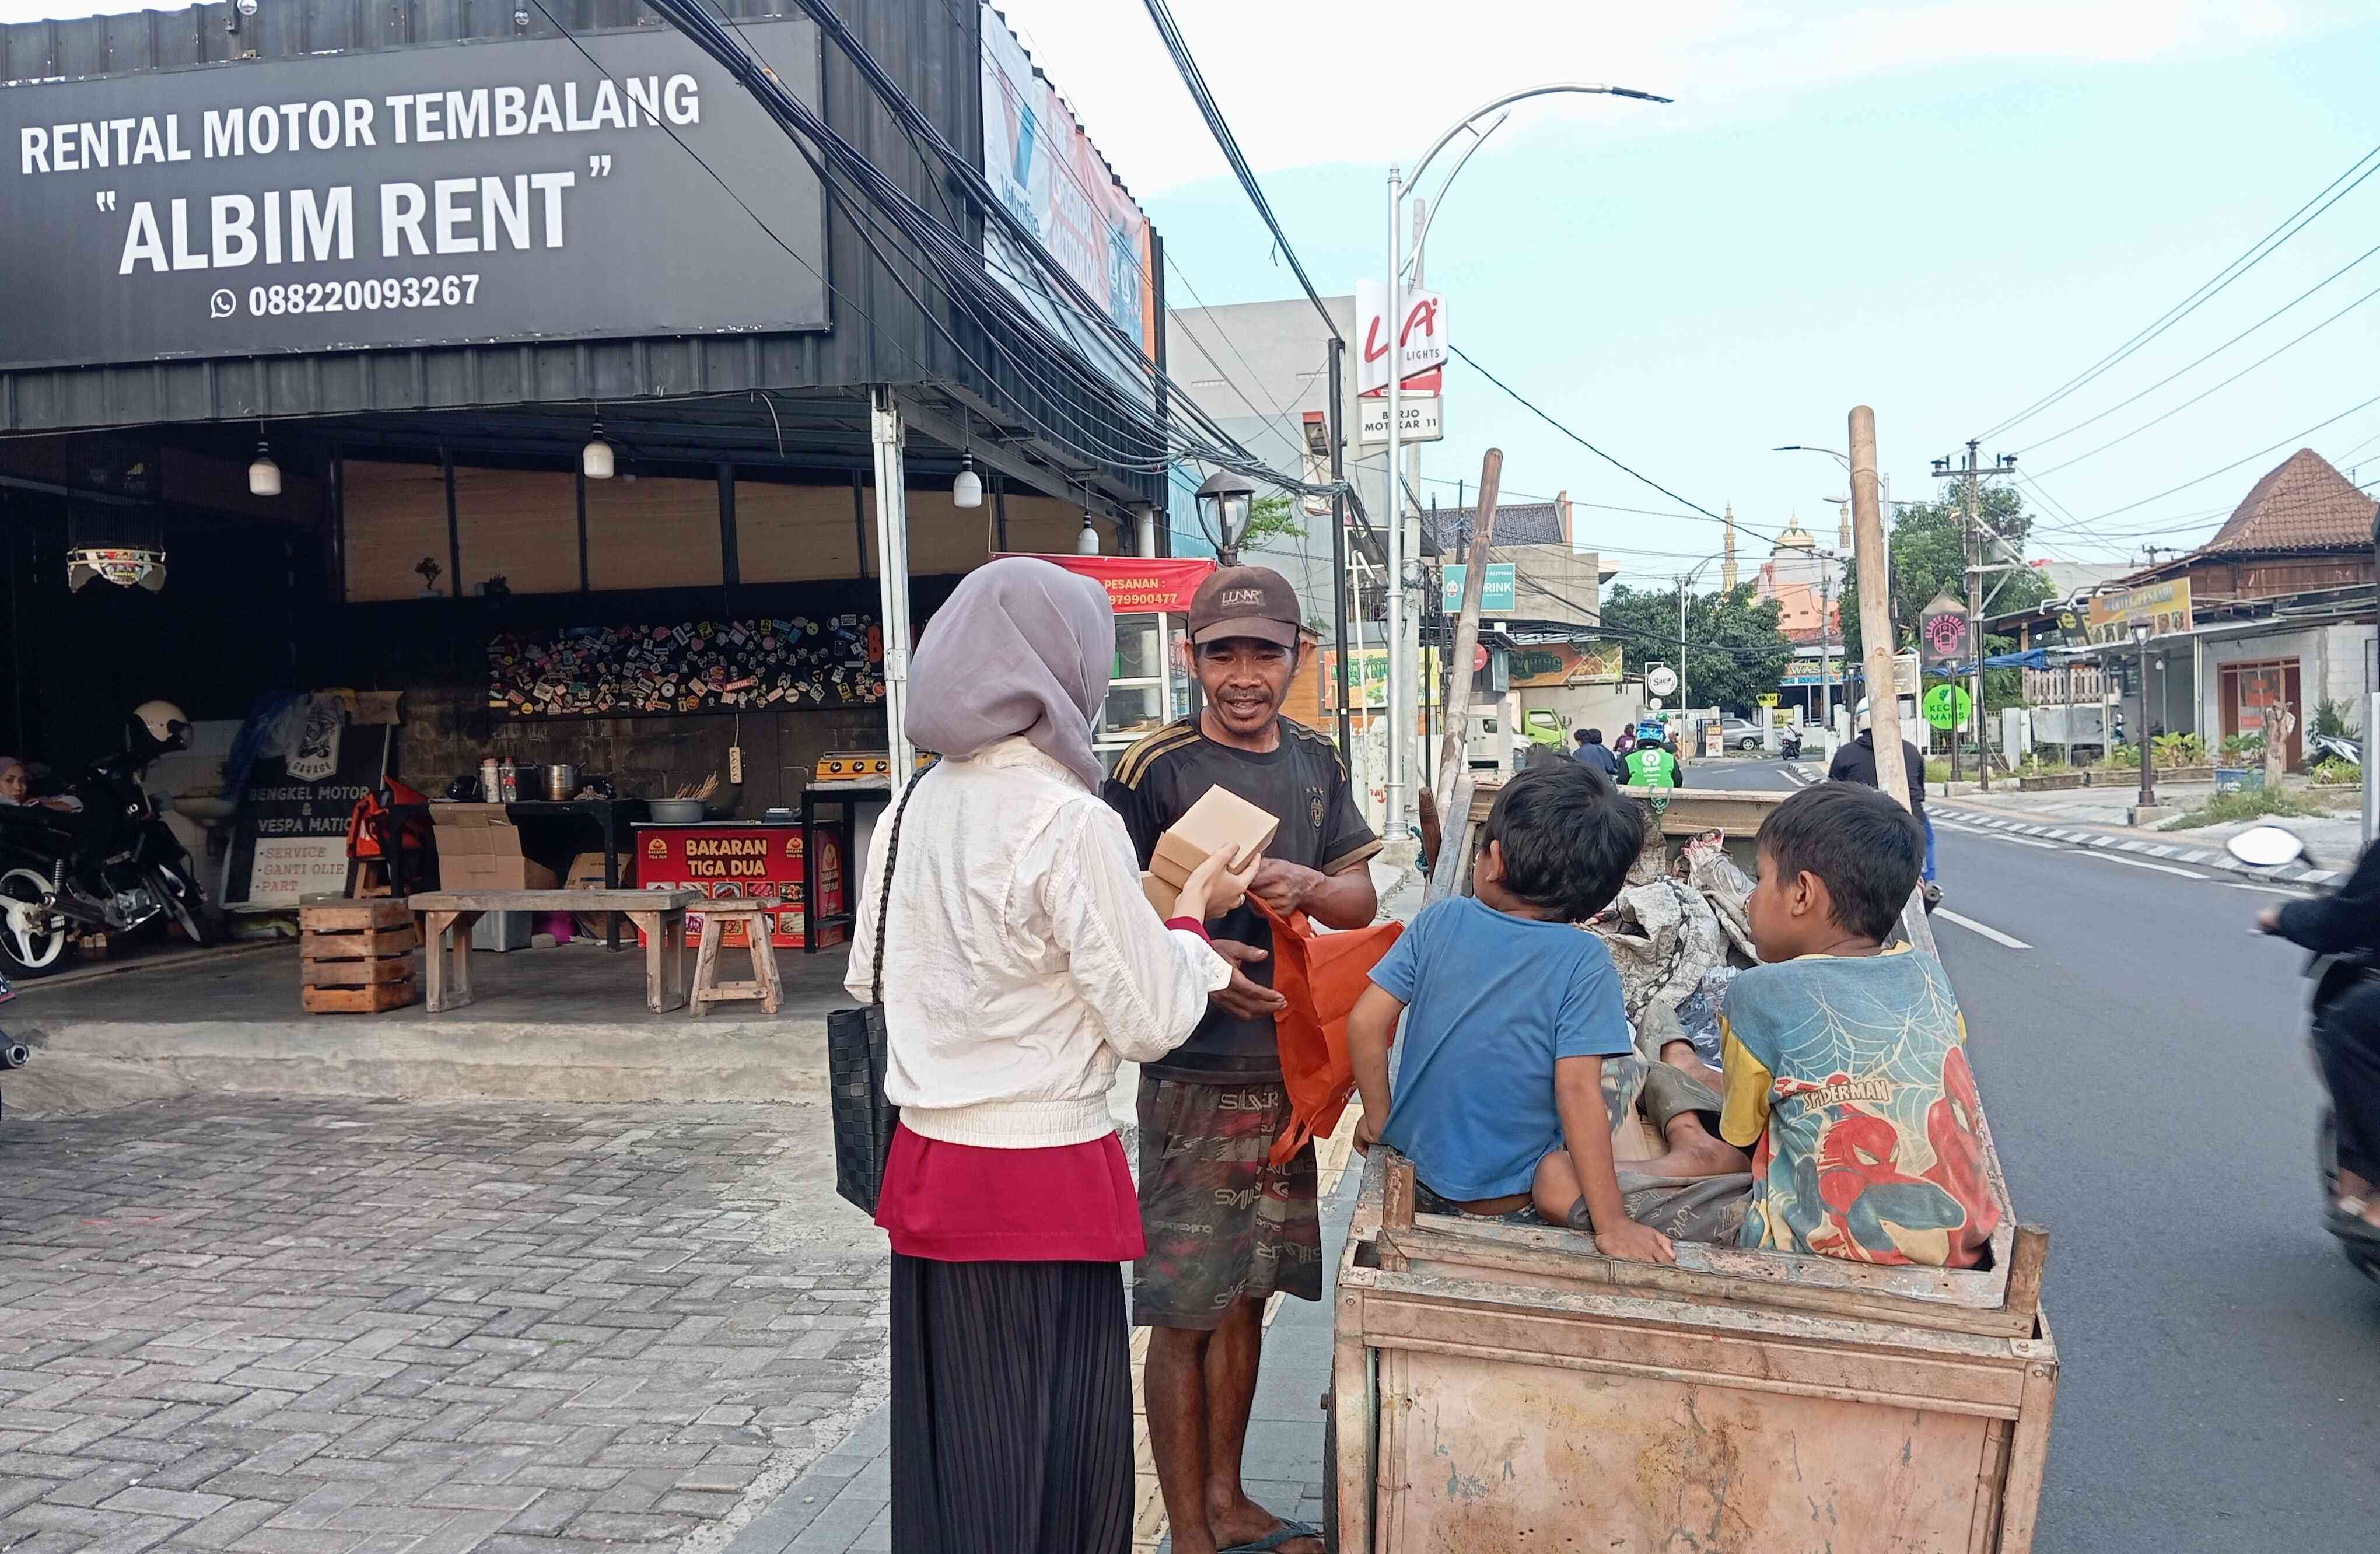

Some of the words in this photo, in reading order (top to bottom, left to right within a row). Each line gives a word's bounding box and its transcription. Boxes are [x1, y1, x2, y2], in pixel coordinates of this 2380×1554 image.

[20, 114, 191, 174] RENTAL
[204, 98, 376, 158] MOTOR
[386, 74, 699, 144] TEMBALANG
[249, 274, 480, 317] 088220093267
[1406, 349, 1440, 360] LIGHTS
[1382, 409, 1419, 419] BRJO
[1104, 578, 1158, 589] PESANAN
[1930, 703, 1964, 712] KECT
[1930, 712, 1964, 721] MANS
[249, 787, 313, 802] BENGKEL
[318, 786, 370, 800] MOTOR
[302, 802, 312, 816] &
[258, 818, 303, 832] VESPA
[309, 818, 352, 832] MATIC
[264, 847, 327, 859] SERVICE
[685, 839, 767, 856] BAKARAN
[263, 864, 307, 875] GANTI
[312, 864, 344, 874] OLIE
[688, 860, 727, 876] TIGA
[730, 860, 766, 876] DUA
[261, 880, 298, 892] PART
